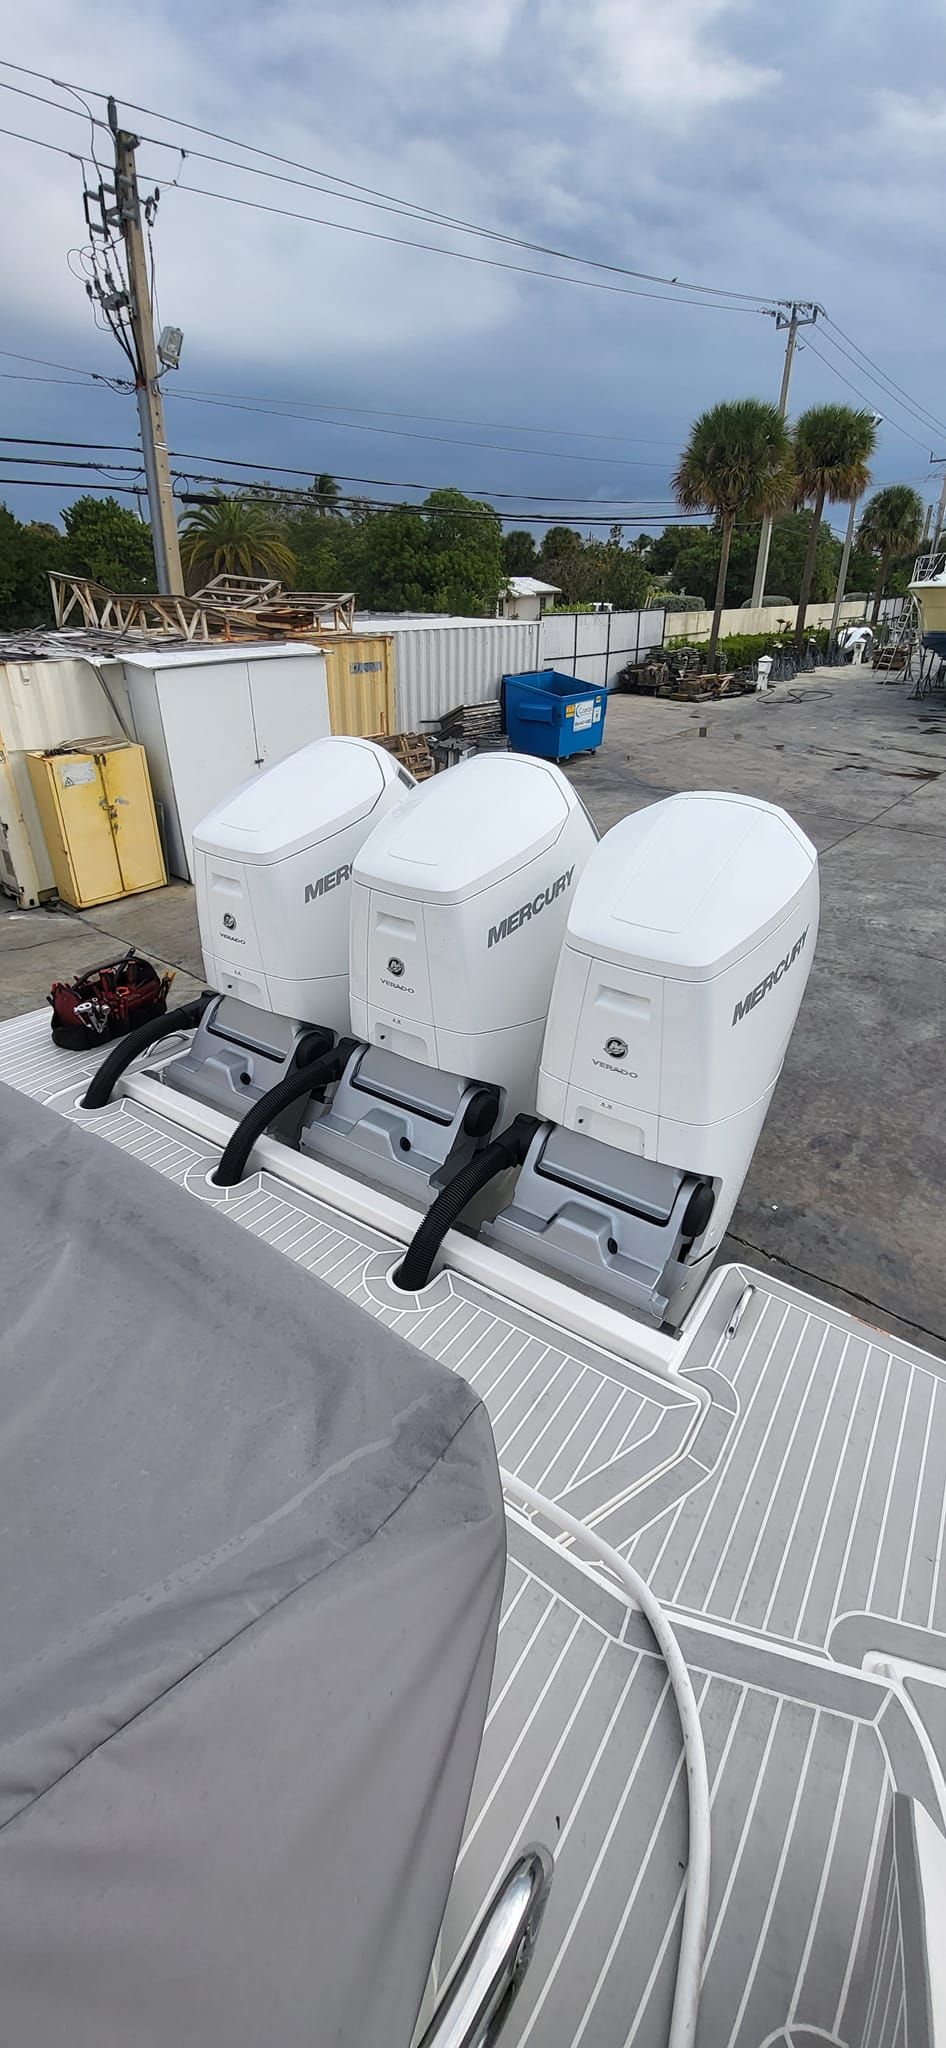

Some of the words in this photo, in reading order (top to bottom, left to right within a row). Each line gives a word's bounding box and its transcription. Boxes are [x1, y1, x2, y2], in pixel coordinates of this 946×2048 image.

[487, 864, 577, 948] MERCURY
[219, 932, 246, 945] VERADO
[731, 923, 810, 1026] MERCURY
[379, 977, 415, 994] VERADO
[591, 1058, 638, 1079] VERADO
